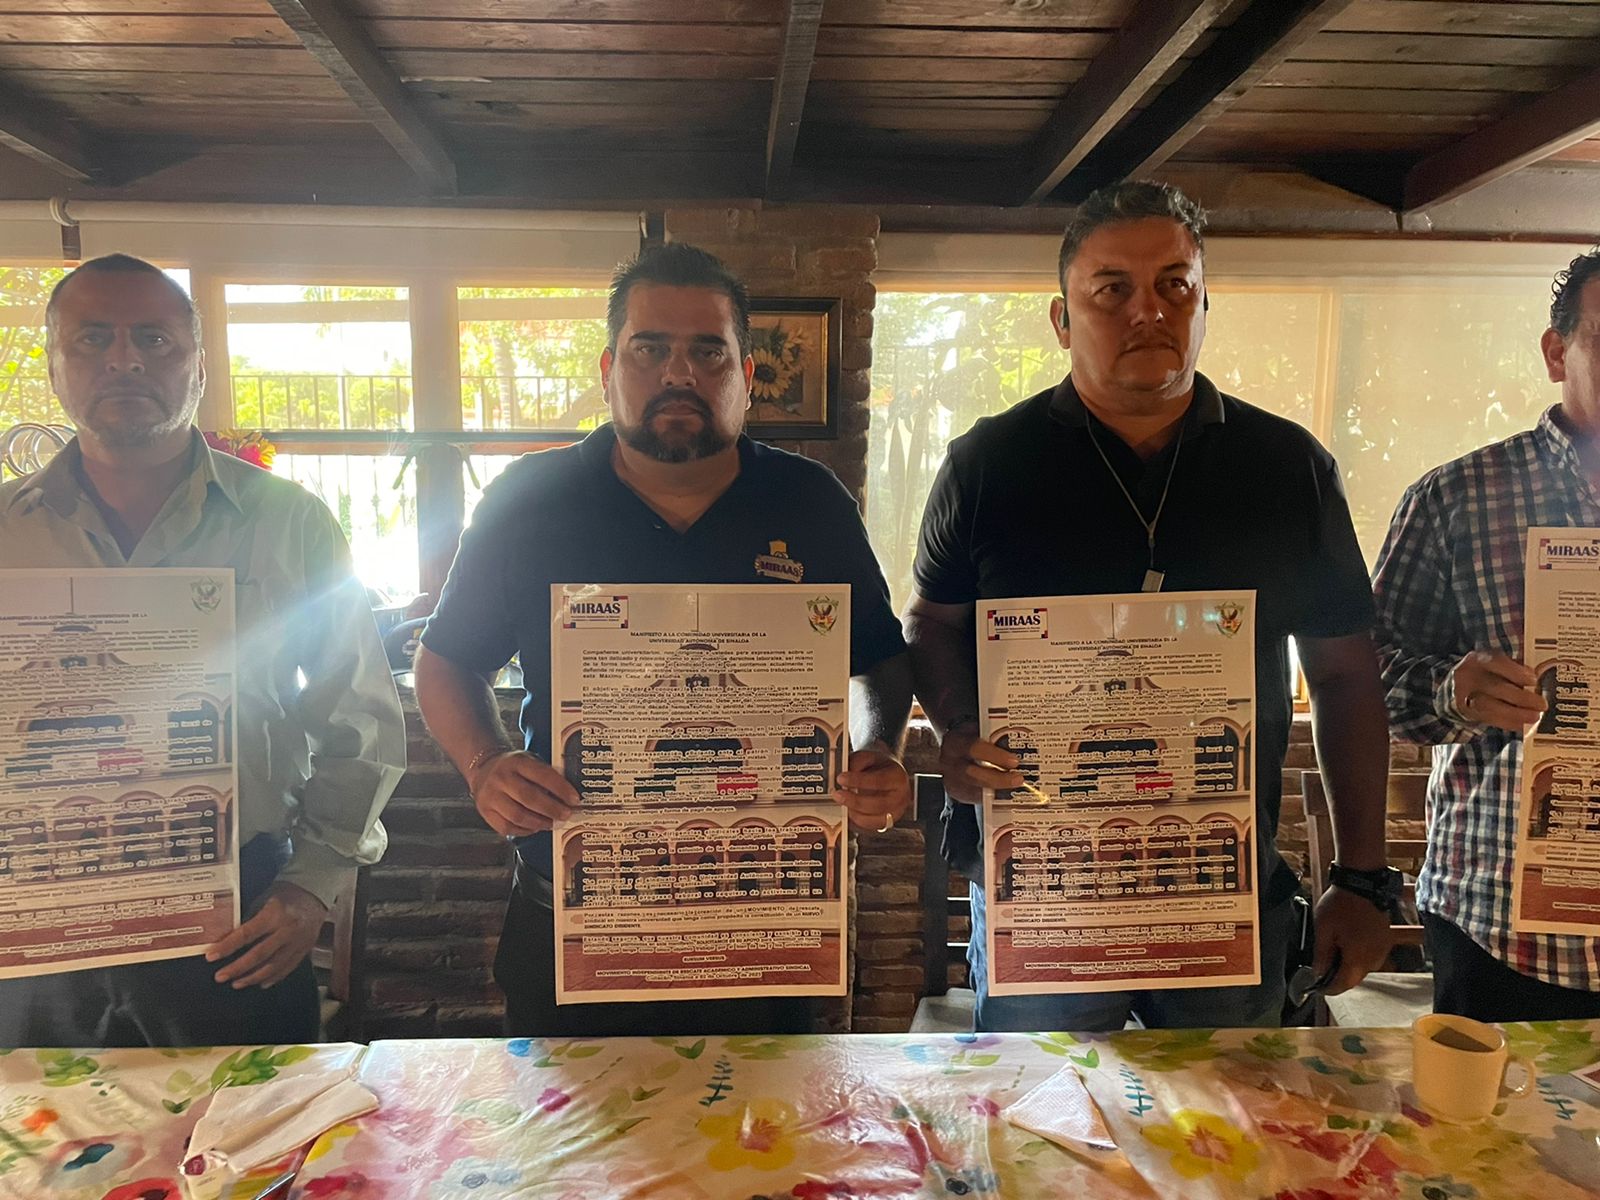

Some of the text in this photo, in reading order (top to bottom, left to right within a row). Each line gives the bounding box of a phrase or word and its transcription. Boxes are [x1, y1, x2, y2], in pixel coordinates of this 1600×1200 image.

[1547, 546, 1600, 556] MIRAAS
[760, 560, 799, 577] MIRAAS
[570, 603, 620, 614] MIRAAS
[994, 615, 1040, 626] MIRAAS
